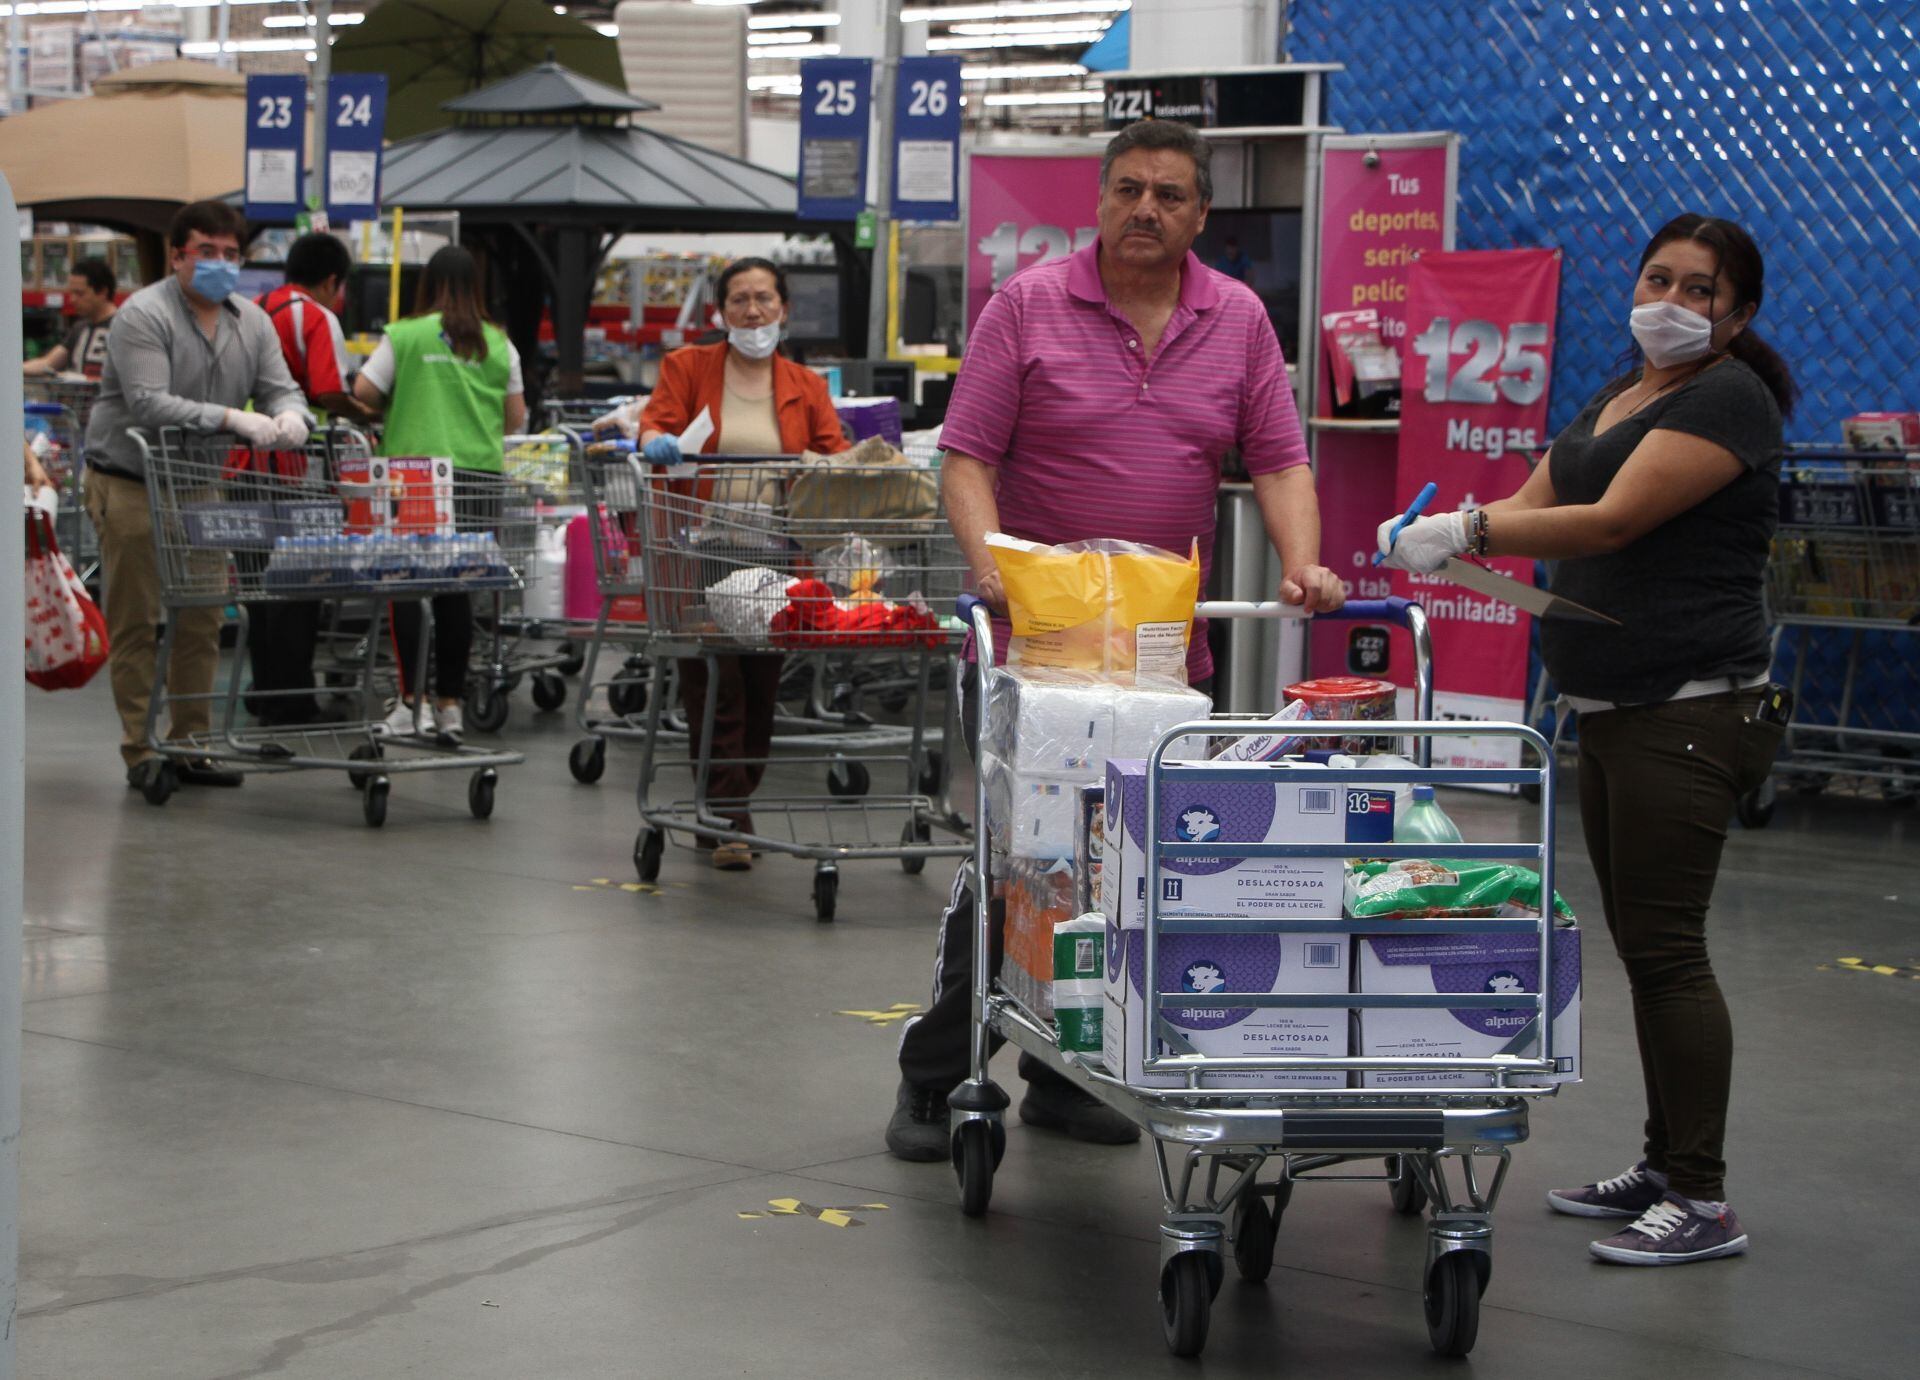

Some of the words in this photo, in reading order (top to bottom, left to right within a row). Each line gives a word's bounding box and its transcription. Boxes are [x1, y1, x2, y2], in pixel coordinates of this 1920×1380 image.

[336, 94, 372, 127] 24
[815, 79, 857, 116] 25
[908, 79, 948, 117] 26
[257, 96, 293, 129] 23
[1387, 173, 1420, 196] Tus
[1350, 209, 1440, 237] deportes,
[1413, 315, 1549, 405] 125
[1446, 416, 1537, 460] Megas
[1413, 591, 1517, 625] ilimitadas
[1361, 651, 1381, 667] go
[1348, 793, 1370, 814] 16
[1237, 879, 1325, 887] DESLACTOSADA
[1182, 1008, 1224, 1022] alpura
[1485, 1016, 1526, 1029] alpura
[1243, 1033, 1330, 1042] DESLACTOSADA
